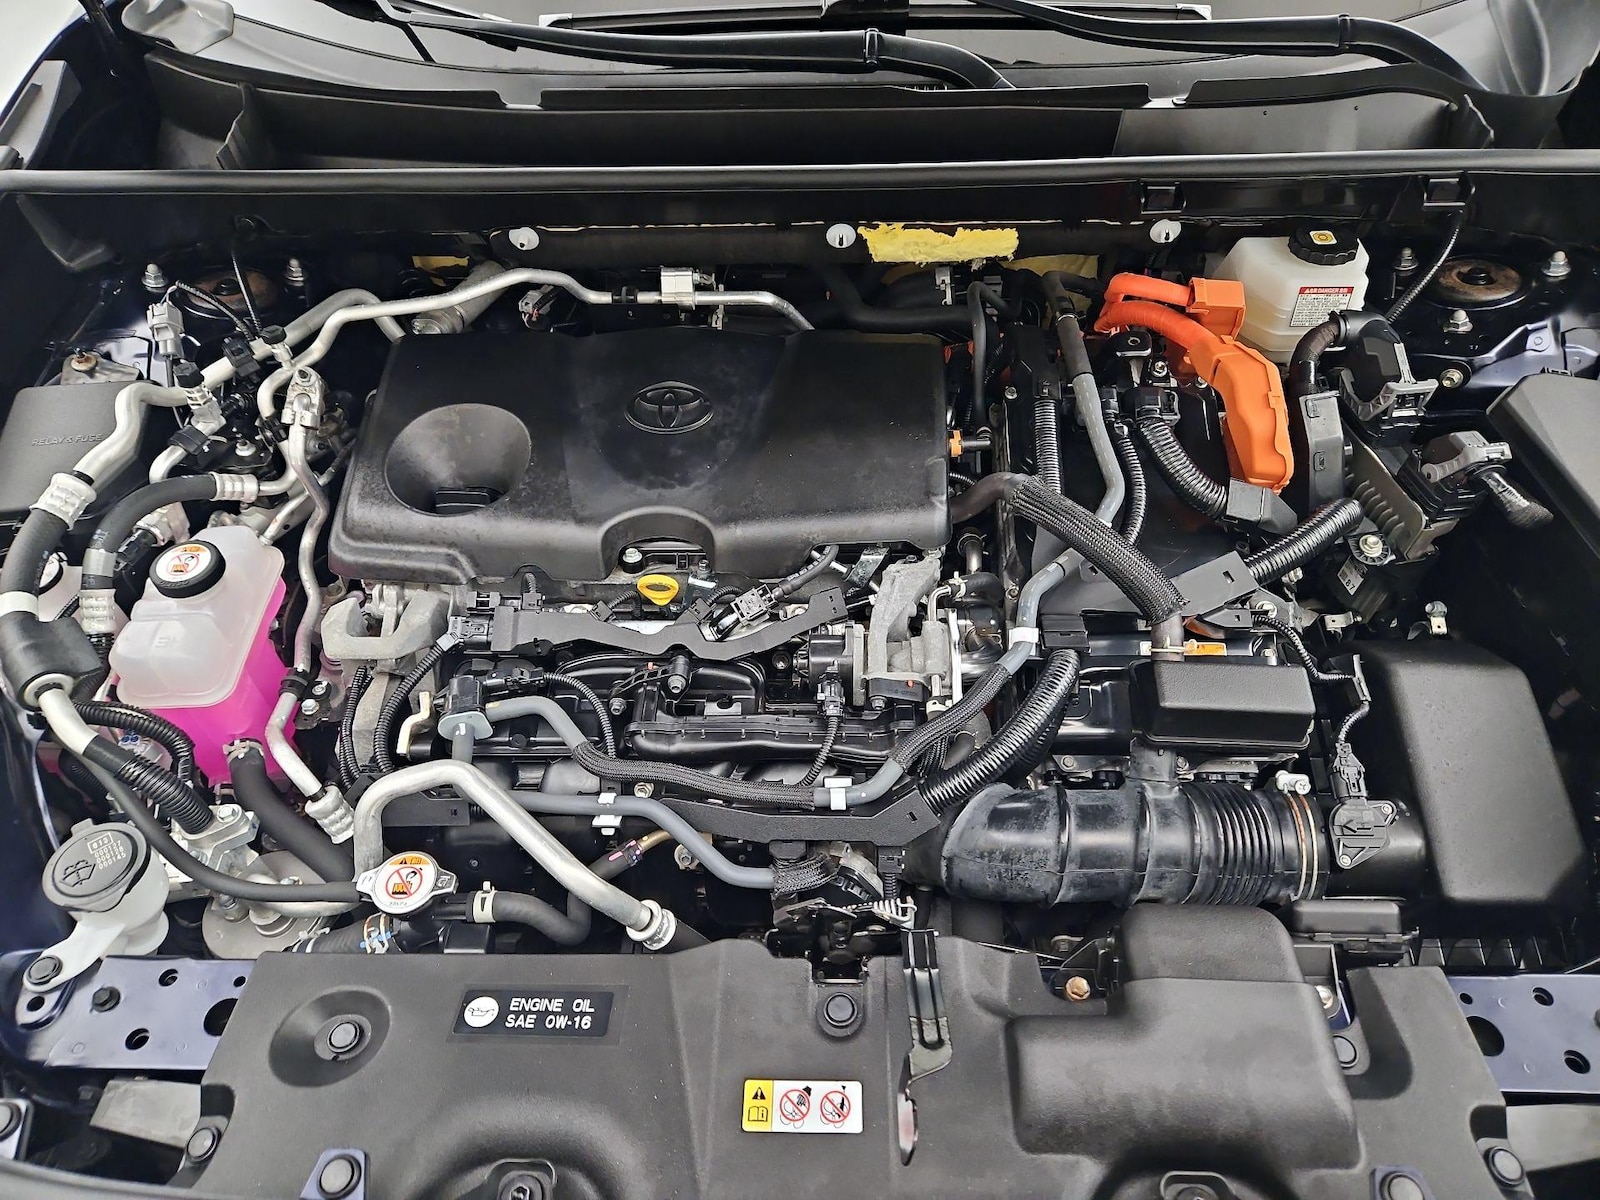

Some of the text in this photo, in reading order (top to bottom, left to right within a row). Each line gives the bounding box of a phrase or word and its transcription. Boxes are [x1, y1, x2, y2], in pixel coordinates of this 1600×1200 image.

[32, 437, 65, 447] RELAY
[74, 433, 103, 444] FUSE
[509, 997, 595, 1013] ENGINE OIL
[505, 1014, 592, 1029] SAE 0W-16
